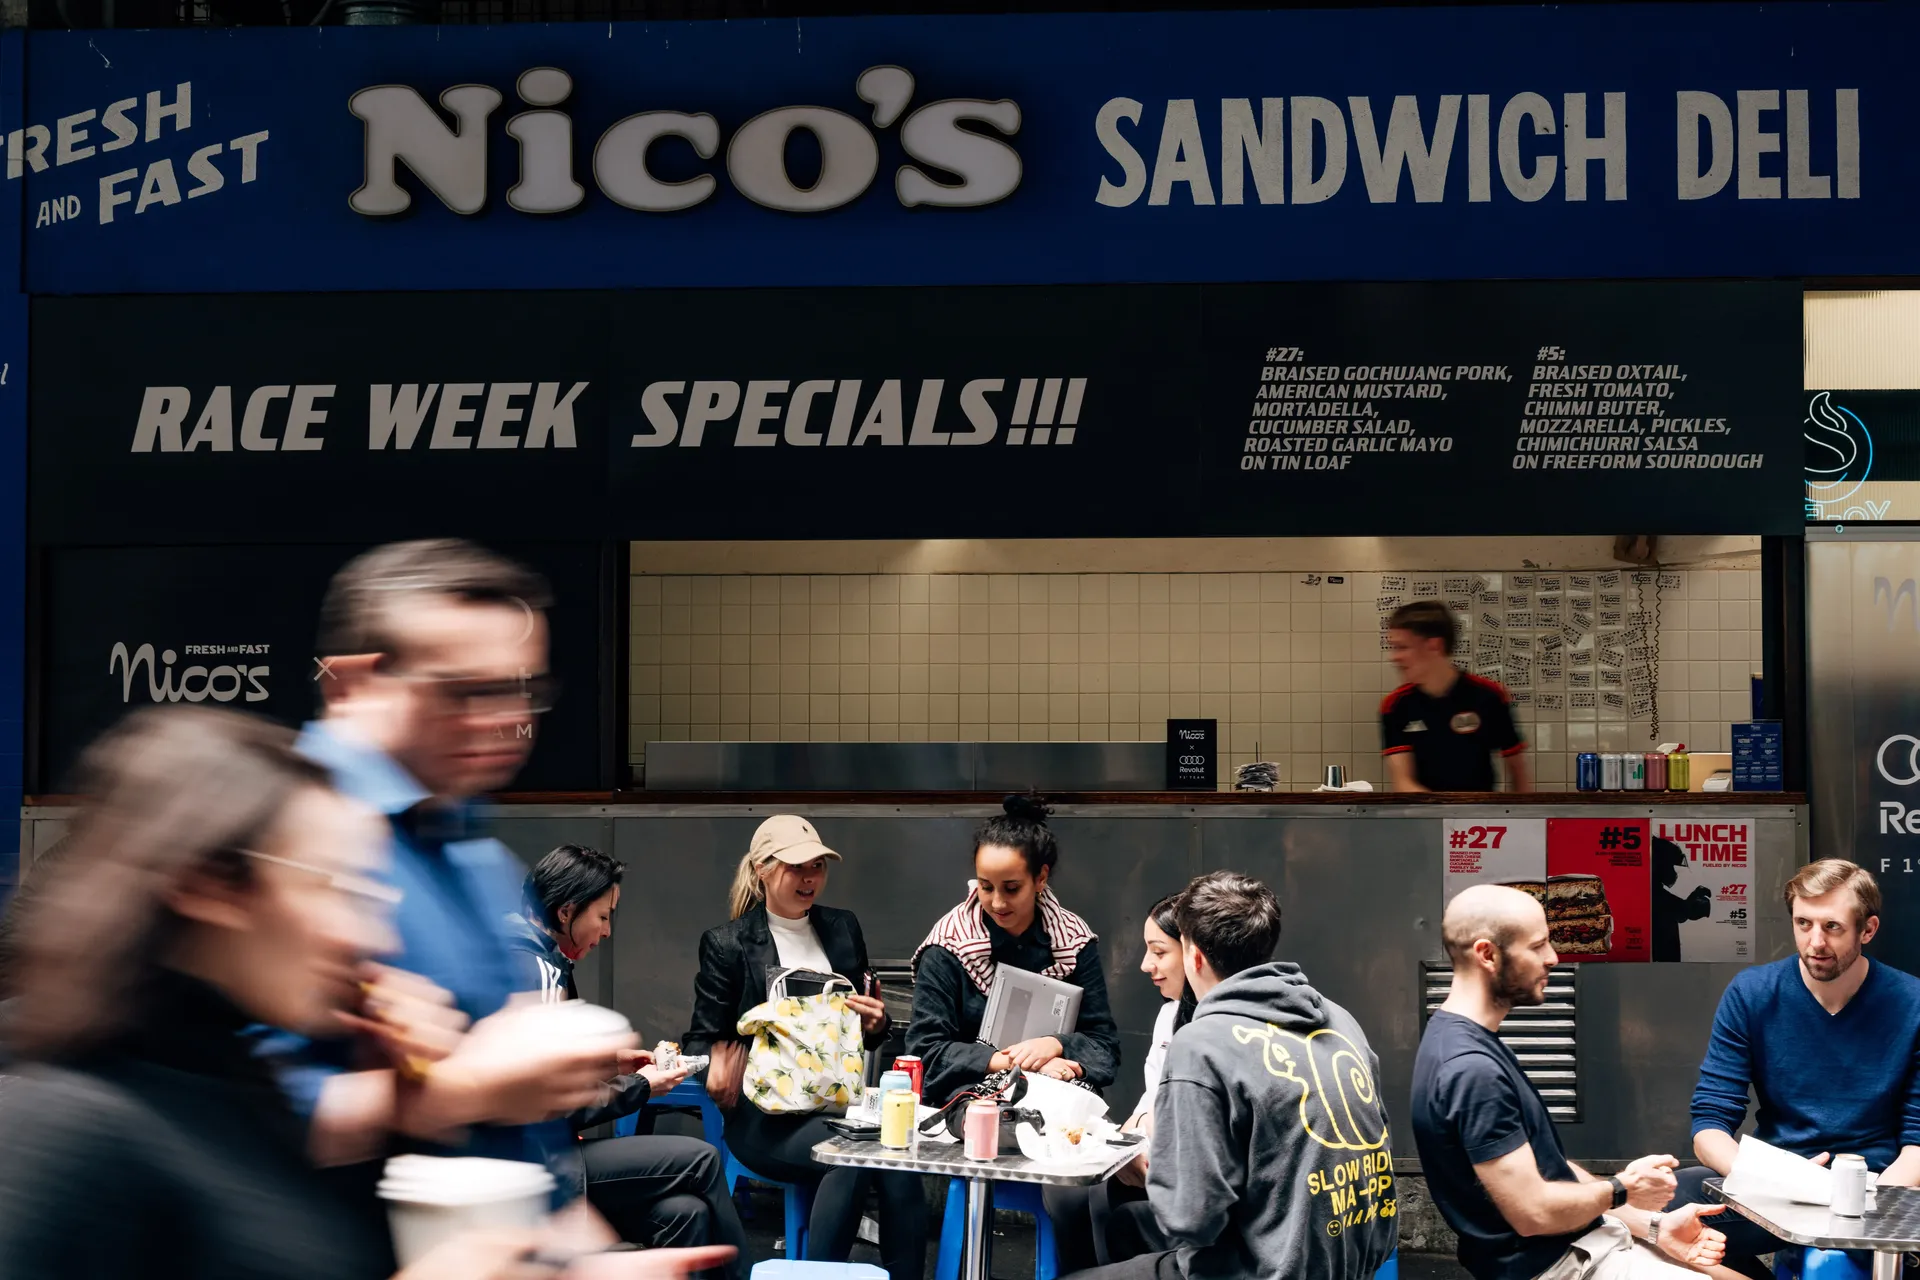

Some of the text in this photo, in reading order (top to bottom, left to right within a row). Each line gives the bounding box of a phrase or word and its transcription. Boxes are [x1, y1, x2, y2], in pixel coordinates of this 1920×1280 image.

[0, 81, 192, 180] RESH
[348, 66, 1022, 216] Nico's
[1095, 88, 1861, 208] SANDWICH DELI
[35, 130, 269, 229] AND FAST
[1265, 347, 1304, 362] #27:
[1537, 346, 1566, 361] #5:
[1260, 365, 1514, 382] BRAISED GOCHUJANG PORK,
[1532, 364, 1688, 381] BRAISED OXTAIL,
[1256, 384, 1448, 400] AMERICAN MUSTARD,
[1528, 382, 1675, 400] FRESH TOMATO,
[131, 378, 1088, 453] RACE WEEK SPECIALS!!!
[1252, 402, 1379, 418] MORTADELLA,
[1524, 400, 1665, 417] CHIMMI BUTER,
[1248, 420, 1416, 436] CUCUMBER SALAD,
[1519, 418, 1732, 435] MOZZARELLA, PICKLES,
[1243, 437, 1453, 452] ROASTED GARLIC MAYO
[1516, 436, 1699, 451] CHIMICHURRI SALSA
[1240, 455, 1352, 470] ON TIN LOAF
[1512, 454, 1764, 469] ON FREEFORM SOURDOUGH
[185, 644, 226, 655] FRESH
[239, 644, 270, 655] FAST
[1449, 826, 1507, 849] #27
[1599, 826, 1642, 850] #5
[1659, 824, 1747, 842] LUNCH
[1685, 844, 1747, 862] TIME
[1721, 884, 1747, 894] #27
[1730, 908, 1747, 919] #5
[1307, 1158, 1360, 1195] SLOW
